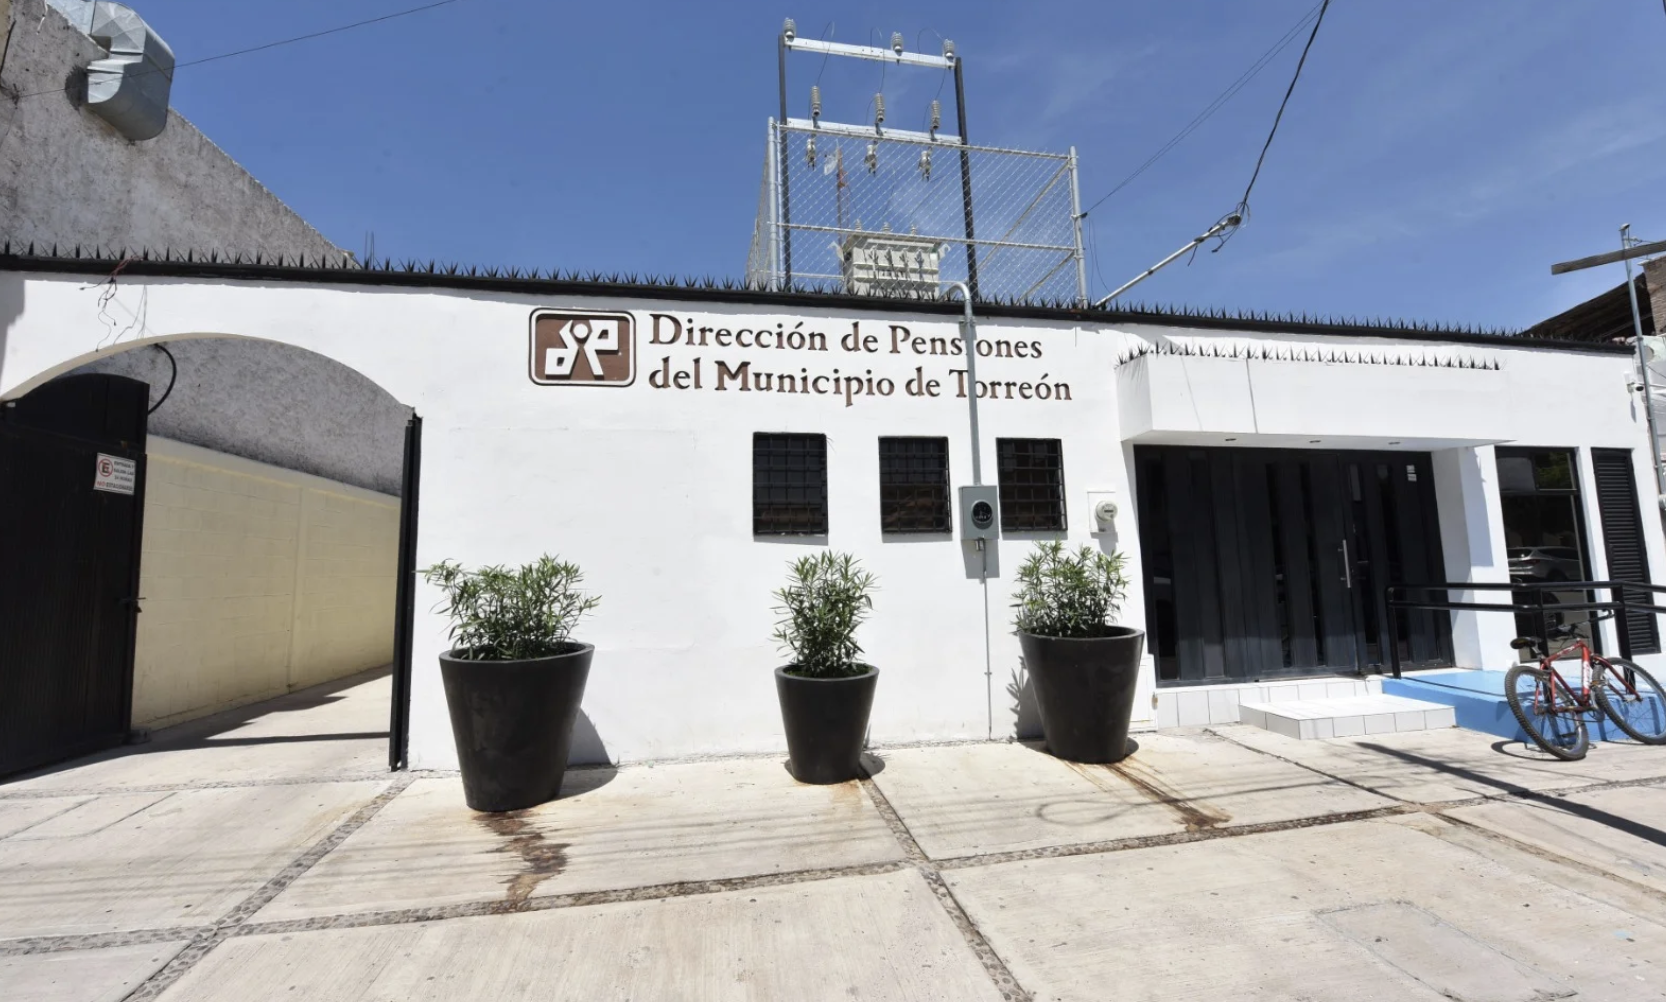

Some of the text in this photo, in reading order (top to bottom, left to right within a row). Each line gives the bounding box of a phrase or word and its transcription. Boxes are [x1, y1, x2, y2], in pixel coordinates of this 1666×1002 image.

[649, 314, 1043, 359] Dirección de Pensones
[649, 356, 1072, 407] del Municipio de Torreón
